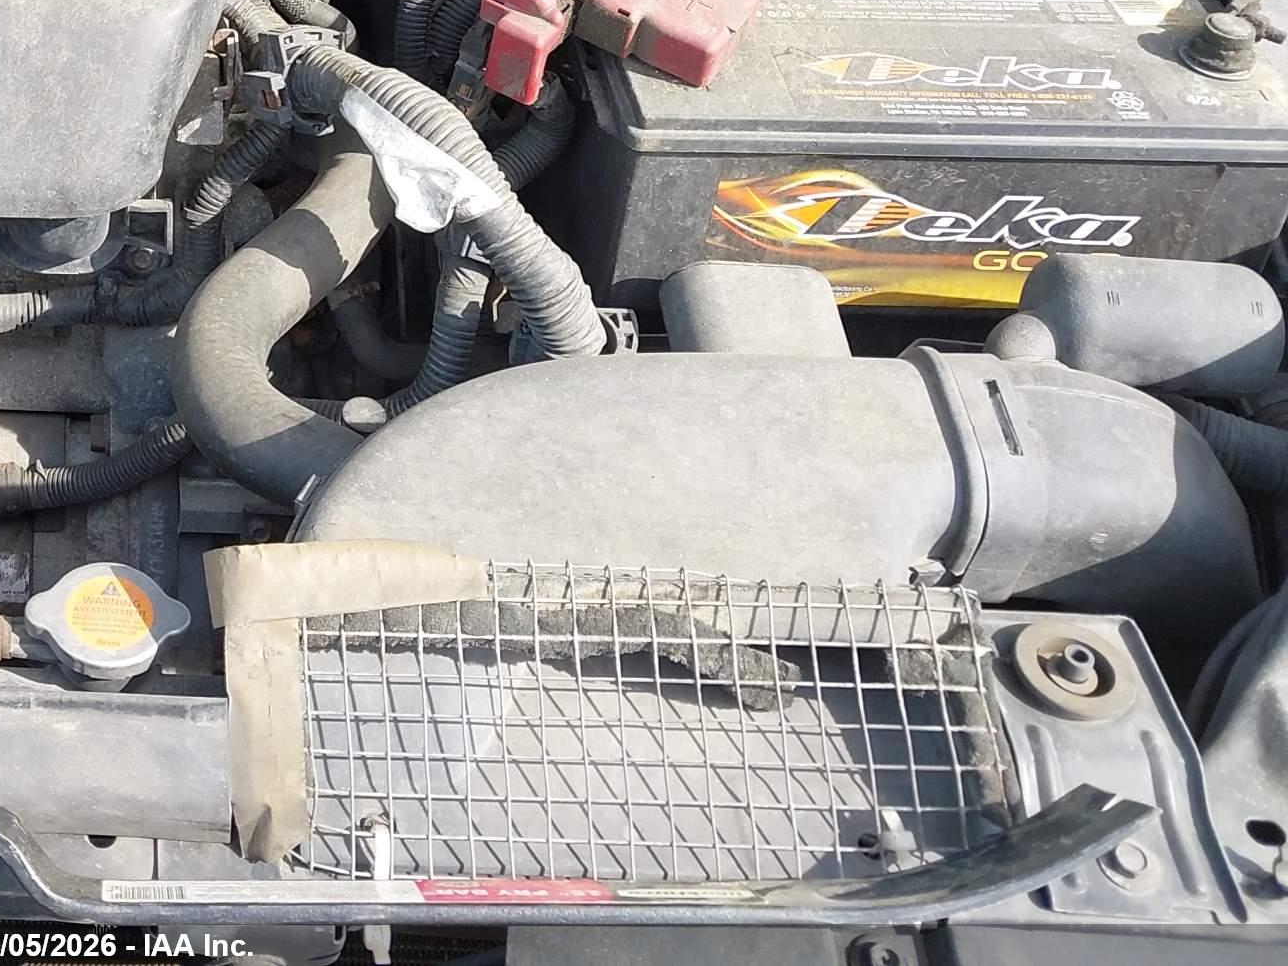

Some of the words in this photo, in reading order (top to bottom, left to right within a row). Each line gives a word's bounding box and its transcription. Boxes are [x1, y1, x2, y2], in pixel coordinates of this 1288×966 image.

[802, 52, 1115, 91] Deka
[774, 189, 1142, 249] Deka
[972, 250, 1049, 272] GO
[83, 596, 142, 609] WARNING
[72, 605, 147, 618] AVERTISSEMENT
[435, 888, 490, 898] BAR
[497, 888, 549, 897] PRY
